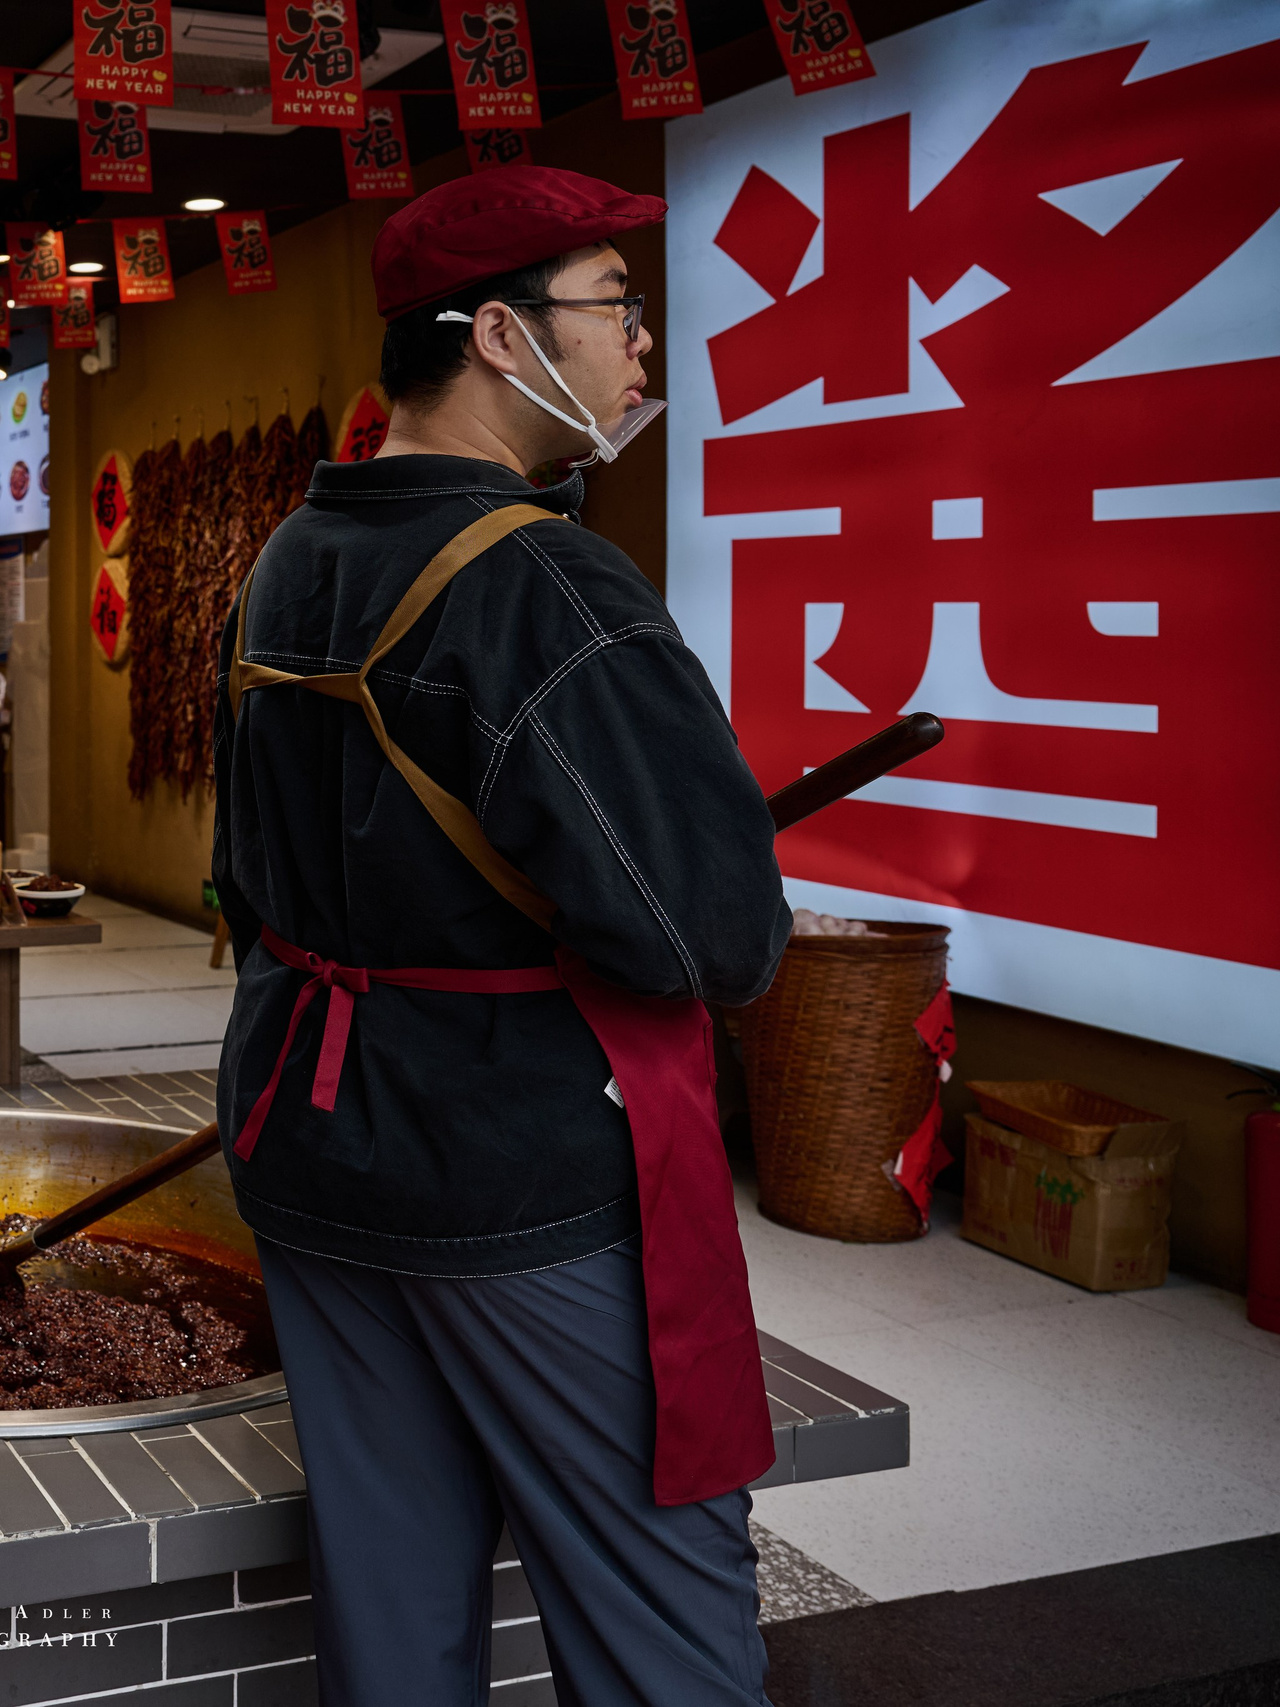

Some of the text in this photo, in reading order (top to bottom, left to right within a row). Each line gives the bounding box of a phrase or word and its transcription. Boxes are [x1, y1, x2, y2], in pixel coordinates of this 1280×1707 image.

[277, 5, 353, 87] 福
[456, 12, 528, 89] 福
[620, 6, 688, 78] 福
[806, 53, 845, 70] HAPPY
[101, 65, 148, 78] HAPPY
[800, 59, 864, 83] NEW YEAR
[86, 79, 164, 95] NEW YEAR
[296, 89, 340, 101] HAPPY
[642, 81, 680, 94] HAPPY
[479, 93, 519, 103] HAPPY
[633, 93, 694, 108] NEW YEAR
[283, 102, 355, 116] NEW YEAR
[469, 105, 532, 117] NEW YEAR
[85, 100, 144, 160] 福
[348, 117, 402, 170] 福
[100, 162, 135, 172] HAPPY
[90, 172, 146, 183] NEW YEAR
[121, 234, 167, 278] 福
[225, 226, 267, 269] 福
[13, 236, 60, 281] 福
[704, 40, 1280, 968] 酱
